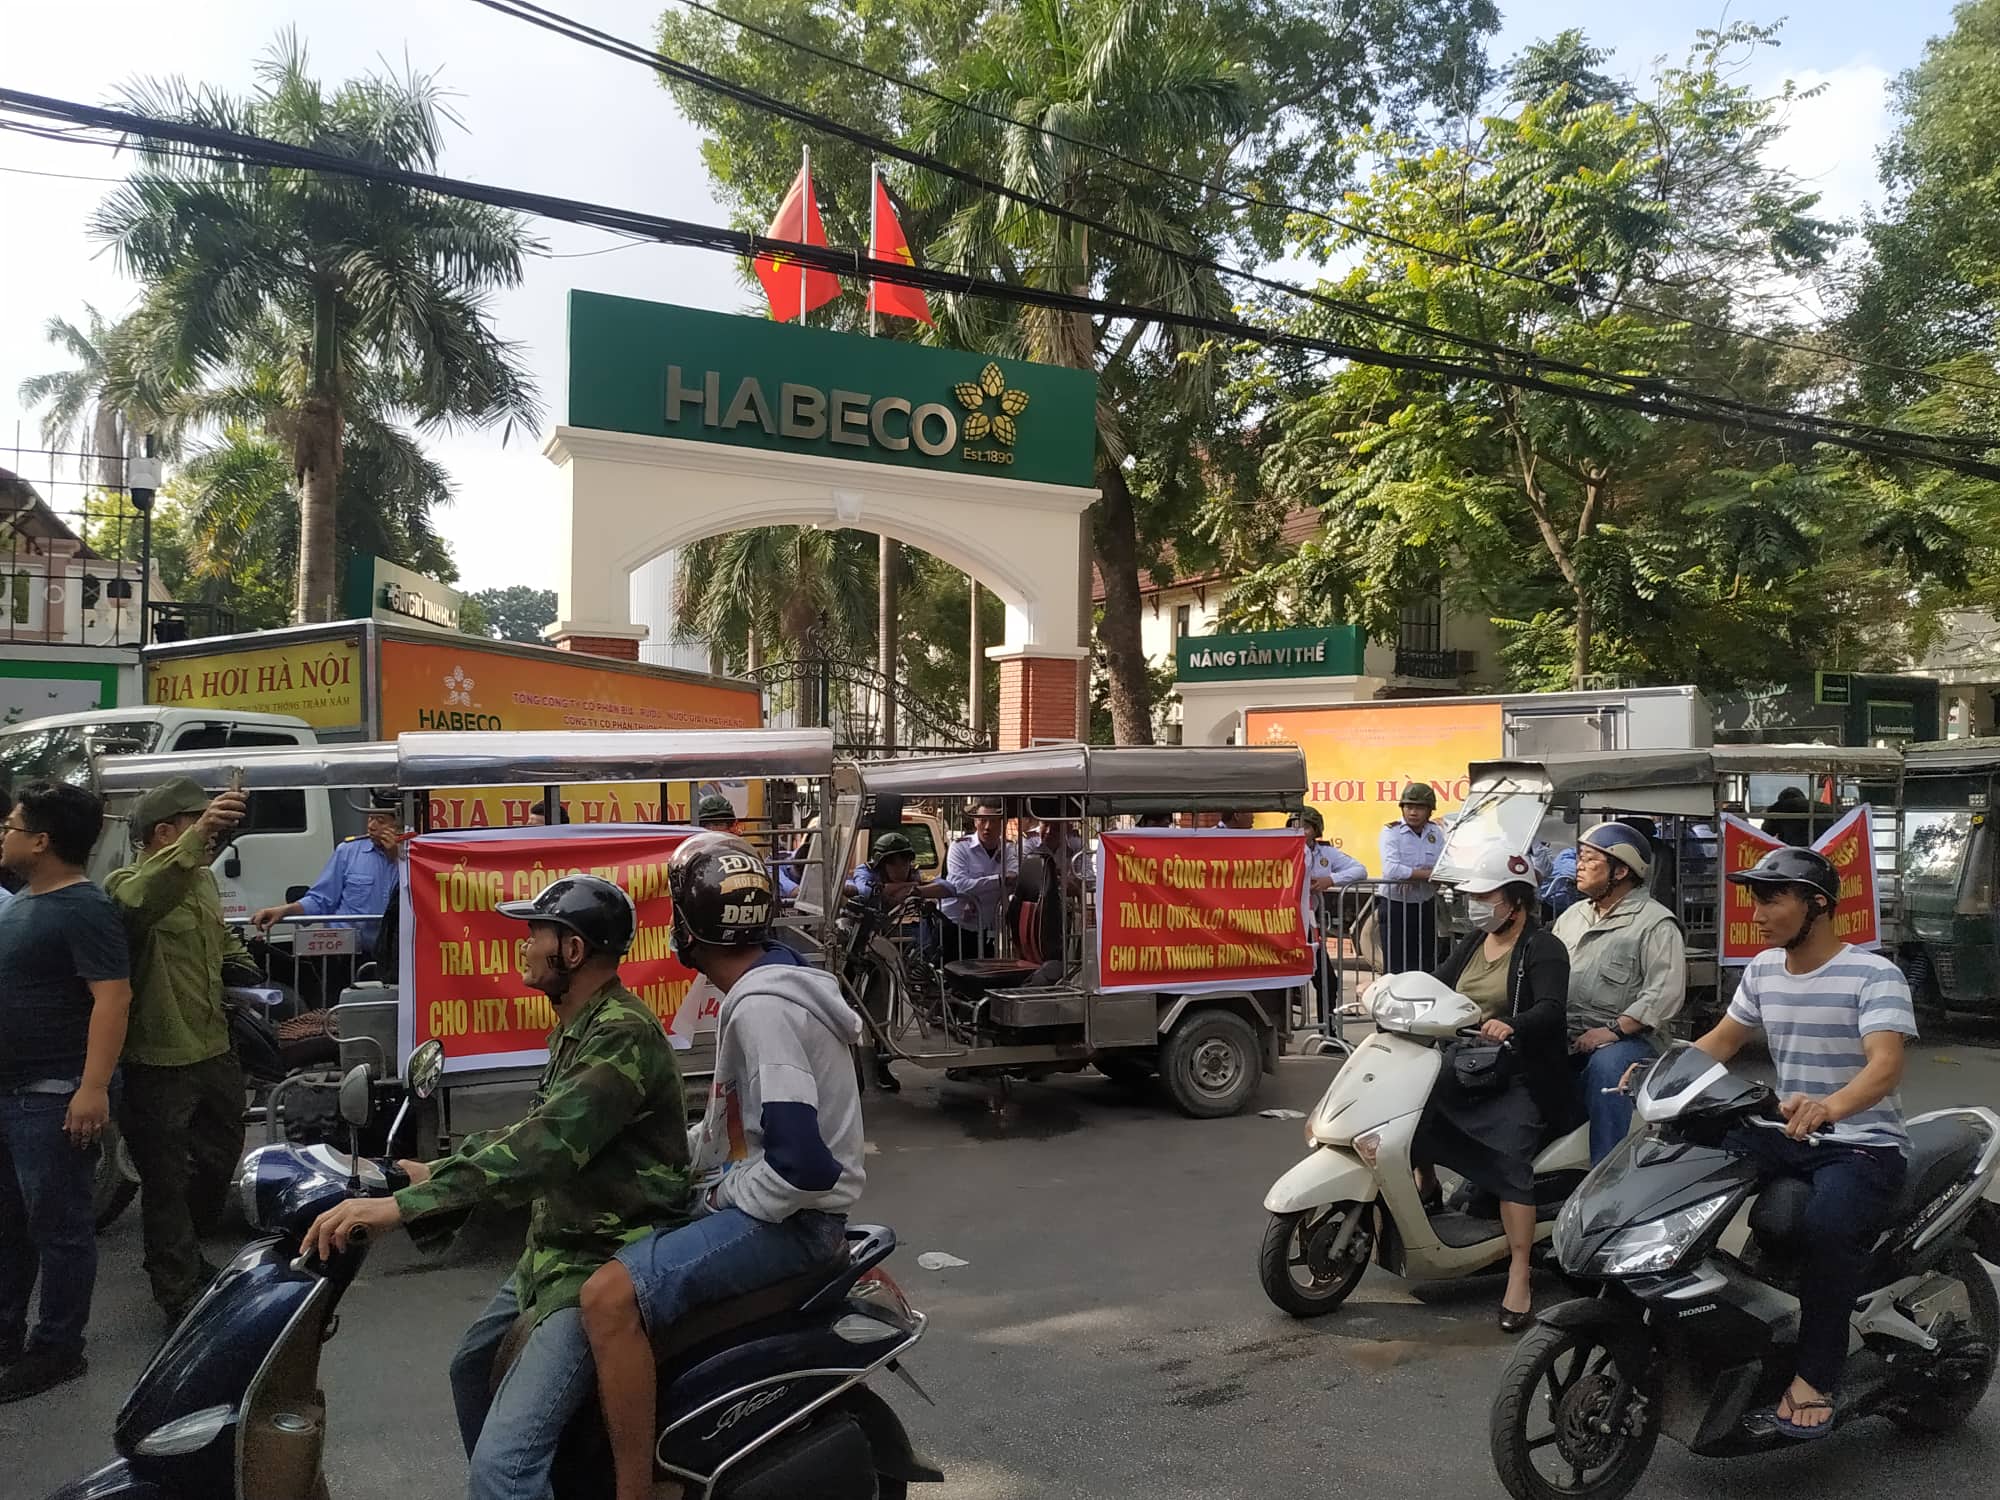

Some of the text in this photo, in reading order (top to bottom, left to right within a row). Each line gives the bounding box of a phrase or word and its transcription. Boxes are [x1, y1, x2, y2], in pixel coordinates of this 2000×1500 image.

[664, 365, 957, 458] HABECO
[1189, 637, 1328, 668] NÂNG TẦM VỊ THẾ
[155, 651, 351, 704] BIA HƠI HÀ NỘI
[418, 707, 502, 731] HABECO
[1311, 779, 1366, 802] HƠI
[429, 799, 490, 829] BIA
[436, 855, 504, 912] TỔNG
[1115, 845, 1158, 885] TỔNG
[1210, 860, 1229, 889] TY
[1232, 859, 1294, 889] HABECO
[1119, 891, 1142, 928] TRẢ
[1143, 903, 1163, 934] LẠI
[619, 920, 671, 964] HÍNH
[1729, 922, 1747, 945] CHO
[440, 926, 474, 976] TRẢ
[480, 939, 509, 983] LẠI
[1110, 944, 1136, 972] CHO
[1139, 945, 1163, 971] HTX
[429, 1000, 467, 1037] CHO
[473, 997, 510, 1033] HTX
[1678, 1303, 1718, 1318] HONDA
